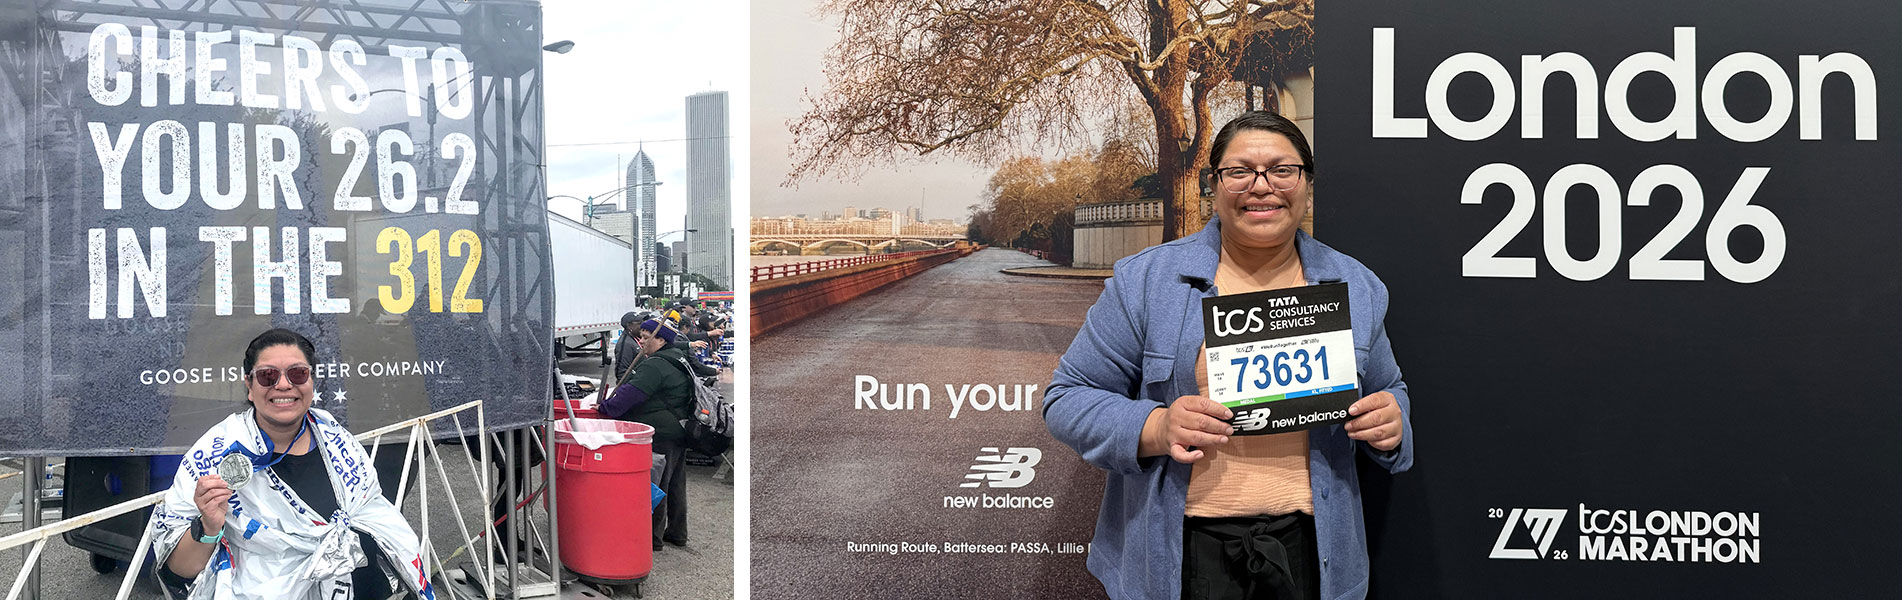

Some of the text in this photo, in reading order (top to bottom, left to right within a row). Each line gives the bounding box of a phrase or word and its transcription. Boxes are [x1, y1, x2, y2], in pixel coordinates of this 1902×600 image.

[87, 23, 475, 120] CHEERS TO
[1372, 26, 1877, 142] London
[88, 119, 481, 215] YOUR 26.2
[1460, 163, 1787, 283] 2026
[88, 225, 484, 320] IN THE 312
[1268, 296, 1299, 308] TATA
[1269, 302, 1340, 319] CONSULTANCY
[1213, 305, 1264, 337] tcs
[1270, 316, 1316, 331] SERVICES
[140, 367, 213, 385] GOOSE
[316, 363, 351, 379] EER
[358, 360, 446, 378] COMPANY
[1231, 345, 1330, 393] 73631
[854, 375, 1038, 419] Run your
[1272, 416, 1297, 429] new
[1299, 408, 1348, 426] balance
[943, 493, 1054, 509] new balance
[1488, 508, 1504, 518] 20
[847, 541, 898, 554] Running
[901, 542, 941, 554] Route,
[944, 542, 1007, 553] Battersea:
[1011, 542, 1053, 554] PASSA,
[1057, 542, 1085, 554] Lillie
[1553, 549, 1569, 560] 26
[1579, 536, 1760, 563] MARATHON
